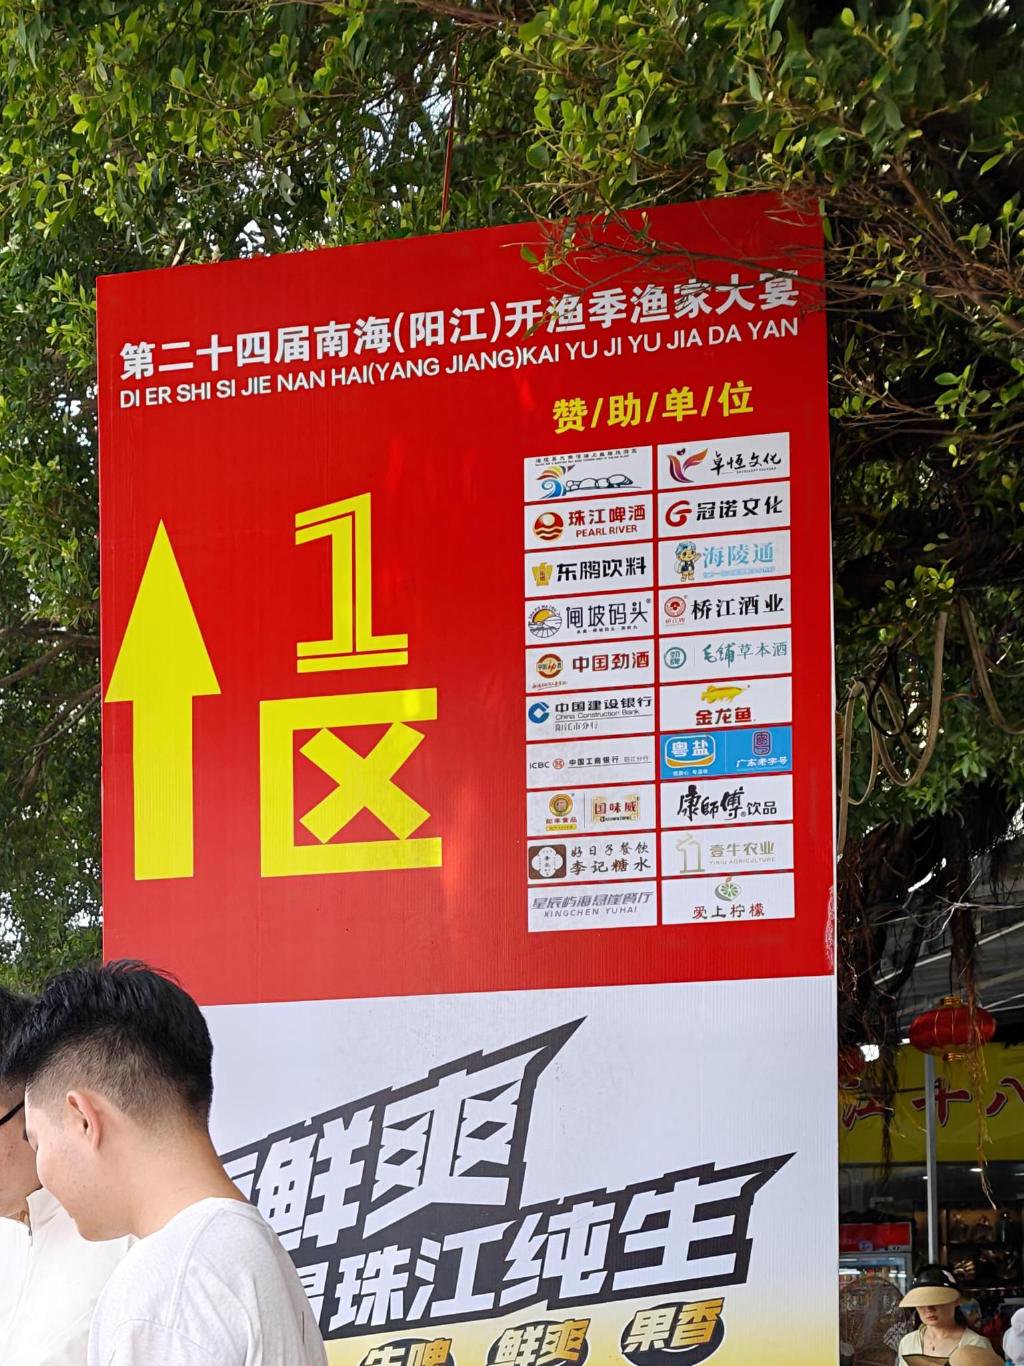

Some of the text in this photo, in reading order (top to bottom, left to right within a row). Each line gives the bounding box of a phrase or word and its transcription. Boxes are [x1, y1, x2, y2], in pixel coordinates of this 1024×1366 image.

[119, 389, 141, 409] DI
[145, 385, 172, 406] ER
[175, 381, 211, 402] SHI
[216, 379, 236, 399] SI
[241, 375, 272, 397] JIE
[277, 369, 326, 393] NAN
[565, 338, 598, 361] YU
[603, 336, 622, 357] JI
[628, 331, 661, 354] YU
[666, 327, 703, 350] JIA
[707, 324, 742, 346] DA
[747, 317, 799, 341] YAN
[553, 380, 754, 434] 赞/助/单/位
[568, 504, 646, 526] 珠江啤酒
[696, 495, 784, 522] 冠诺文化
[575, 524, 638, 538] PEARL RIVER
[703, 541, 775, 569] 海陵通
[556, 556, 647, 582] 东鹏饮料
[295, 492, 408, 674] 1
[690, 593, 785, 620] 桥江酒业
[572, 651, 650, 673] 中国劲酒
[555, 696, 652, 713] 中国建设银行
[556, 708, 640, 721] China Construction Bank
[695, 706, 752, 726] 金龙鱼
[671, 740, 710, 757] 粤盐
[529, 761, 550, 769] ICBC
[568, 755, 619, 766] 中国工商银行
[259, 687, 443, 879] 区
[569, 856, 651, 876] 李记糖水
[544, 908, 600, 918] XINGCHEN
[692, 902, 765, 920] 爱上柠檬
[623, 1297, 725, 1353] 果香
